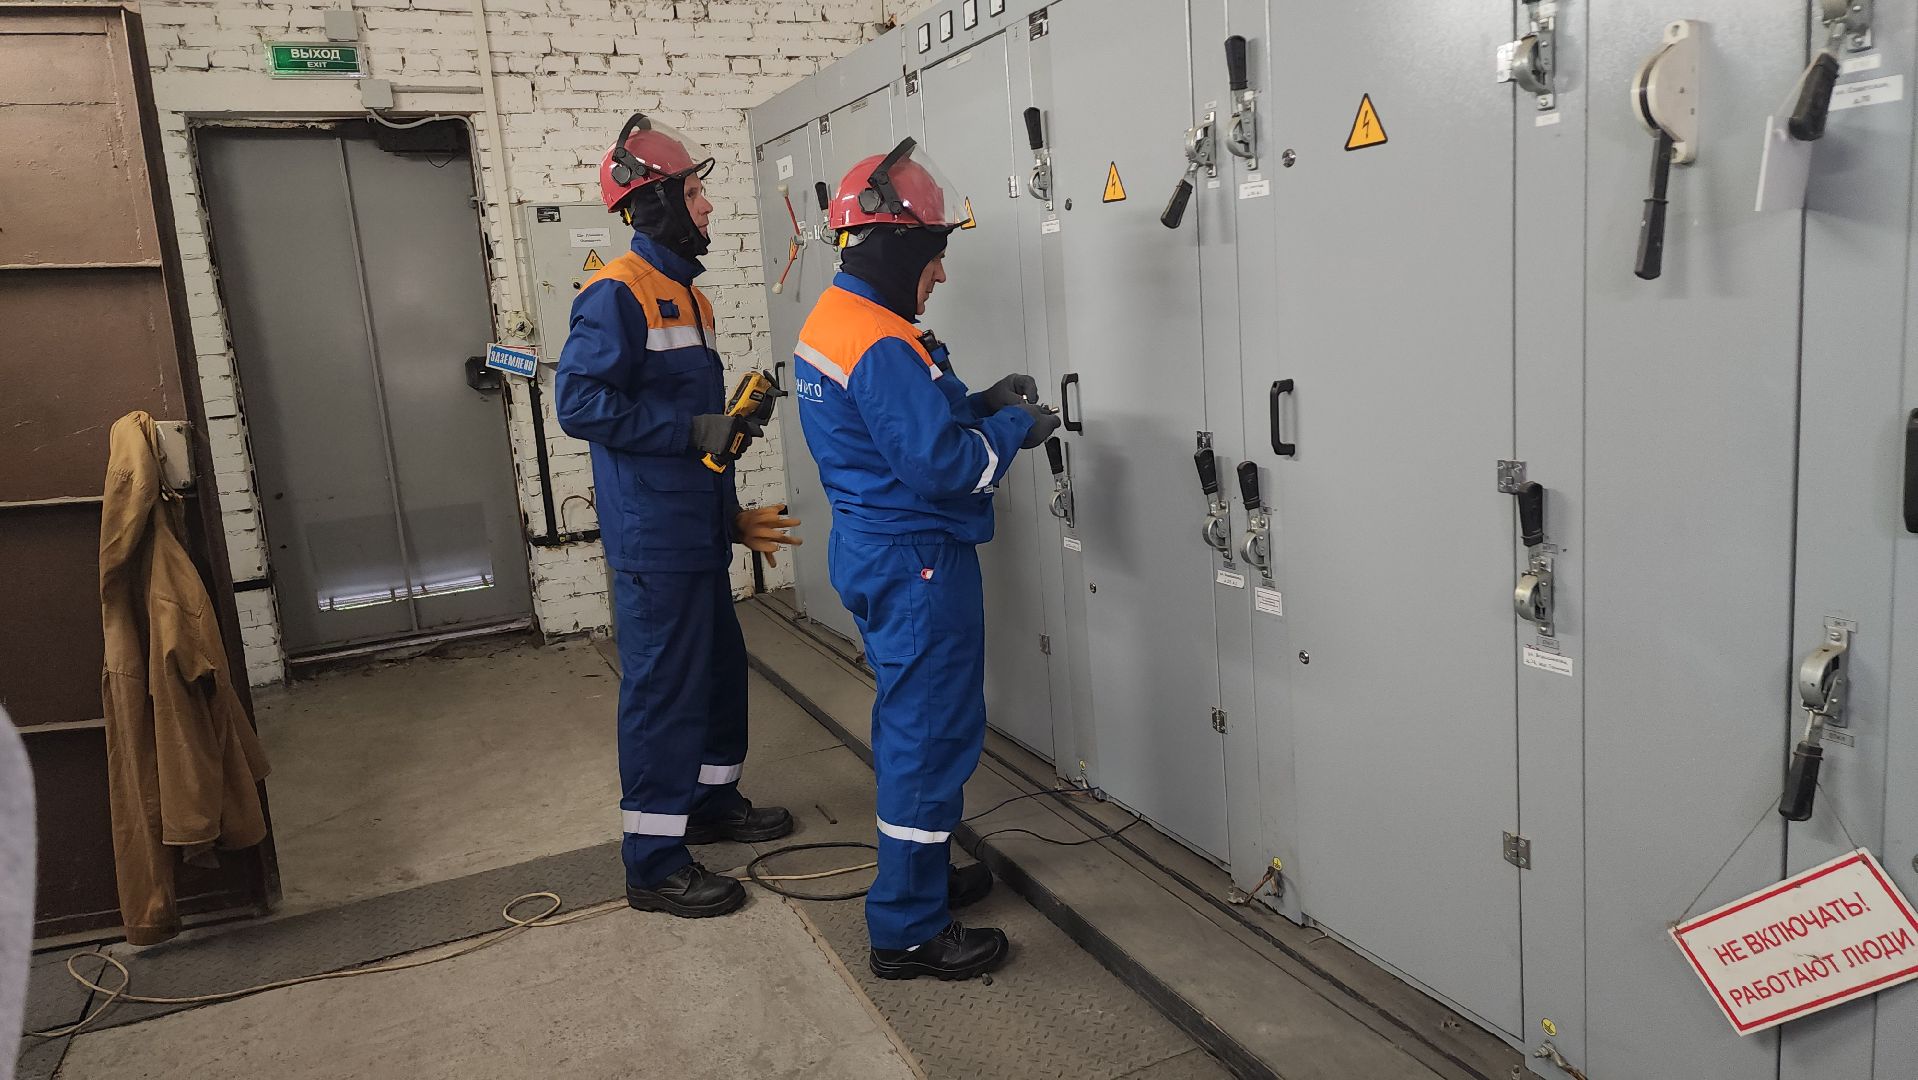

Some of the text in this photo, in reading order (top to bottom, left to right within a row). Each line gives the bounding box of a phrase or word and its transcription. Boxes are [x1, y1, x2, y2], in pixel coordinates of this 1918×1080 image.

[290, 48, 341, 60] ВЫХОД
[490, 351, 534, 372] ЗАЗЕМЛЕНО
[1713, 891, 1871, 966] НЕ ВКЛЮЧАТЬ!
[1729, 927, 1915, 1008] РАБОТАЮТ ЛЮДИ
